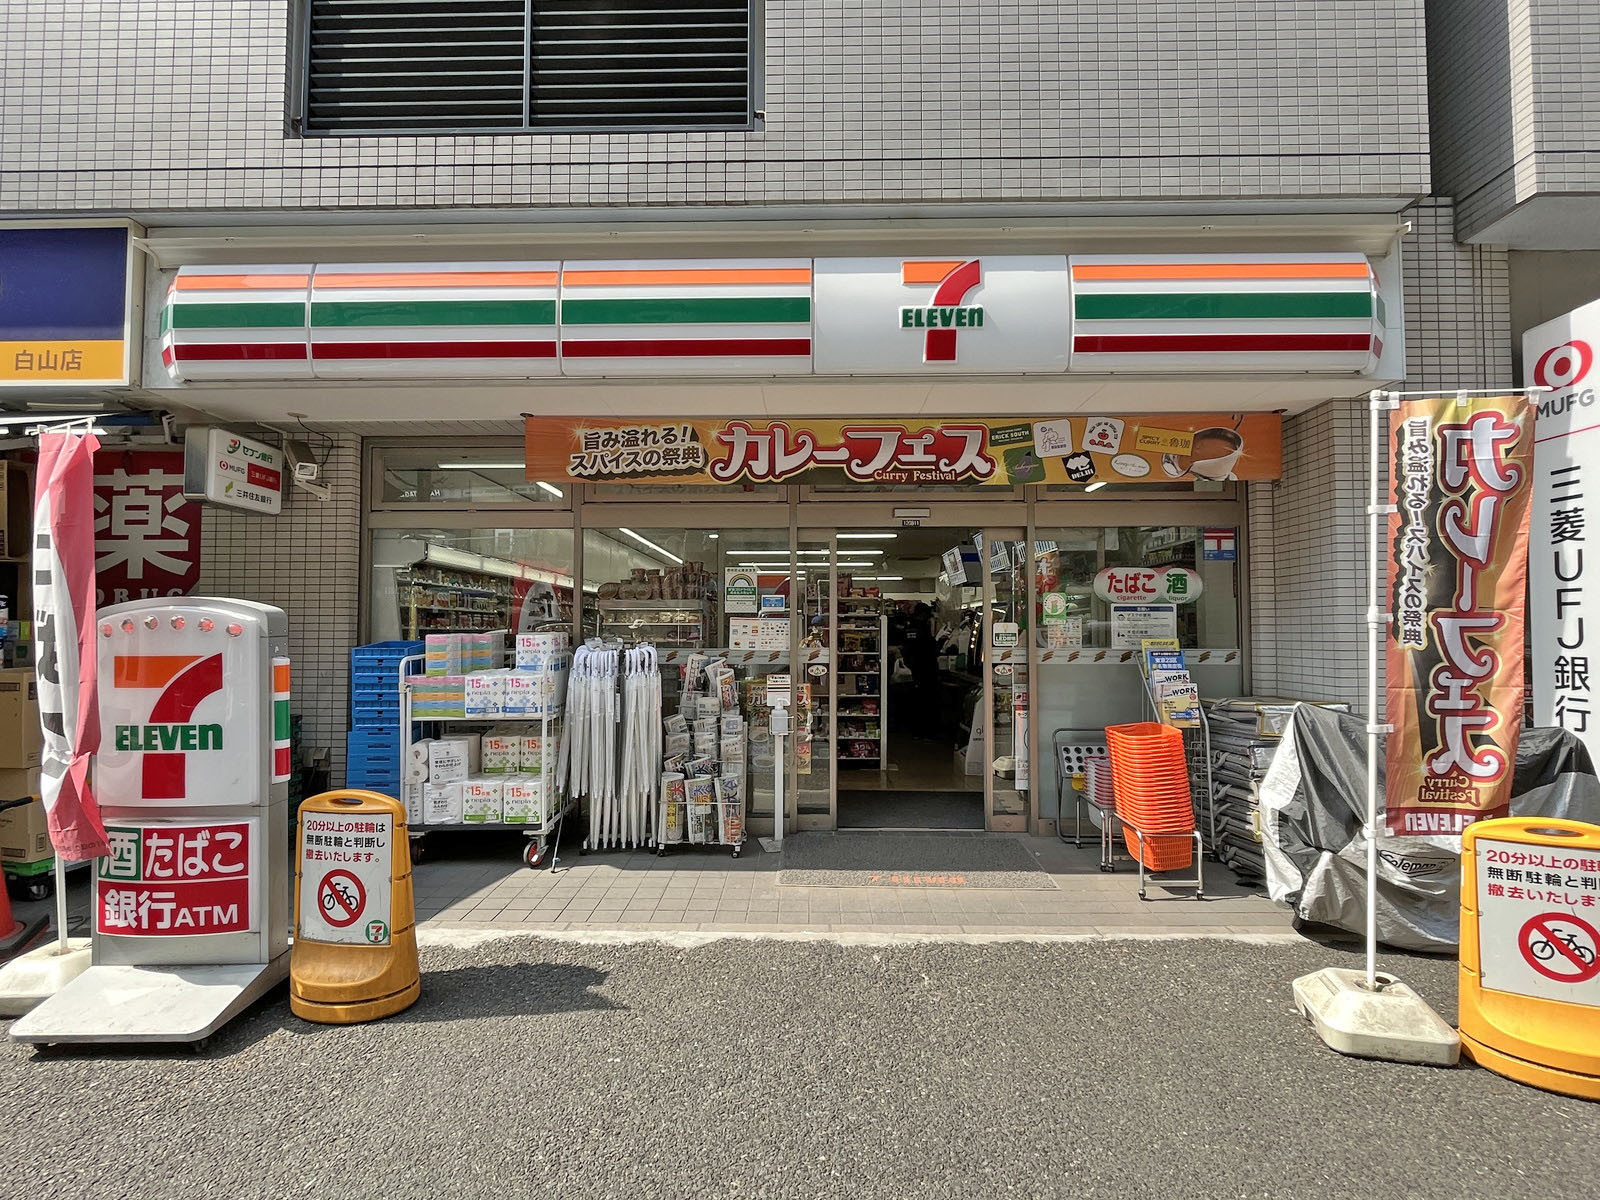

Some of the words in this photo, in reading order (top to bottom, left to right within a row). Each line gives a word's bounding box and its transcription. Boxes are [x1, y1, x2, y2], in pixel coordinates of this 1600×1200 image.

[14, 350, 83, 372] 白山店
[1536, 388, 1595, 420] MUFG
[570, 445, 701, 472] スパイスの祭典
[714, 424, 989, 477] カレーフェス
[229, 464, 246, 474] MUFG
[874, 470, 908, 482] Curry
[913, 470, 956, 481] Festival
[236, 489, 272, 504] 三井住友銀行
[94, 468, 193, 579] 薬
[1107, 572, 1157, 594] たばこ
[1166, 573, 1189, 594] 酒
[1549, 465, 1592, 733] 三菱UFJ銀行
[1164, 673, 1189, 682] WORK
[1172, 686, 1197, 696] WORK
[306, 820, 386, 834] 20分以上の駐輪は
[306, 834, 386, 848] 無断駐輪と判断し
[102, 832, 140, 877] 酒
[145, 830, 244, 876] たばこ
[306, 848, 380, 863] 撤去いたします。
[1487, 866, 1600, 891] 無断駐輪と判
